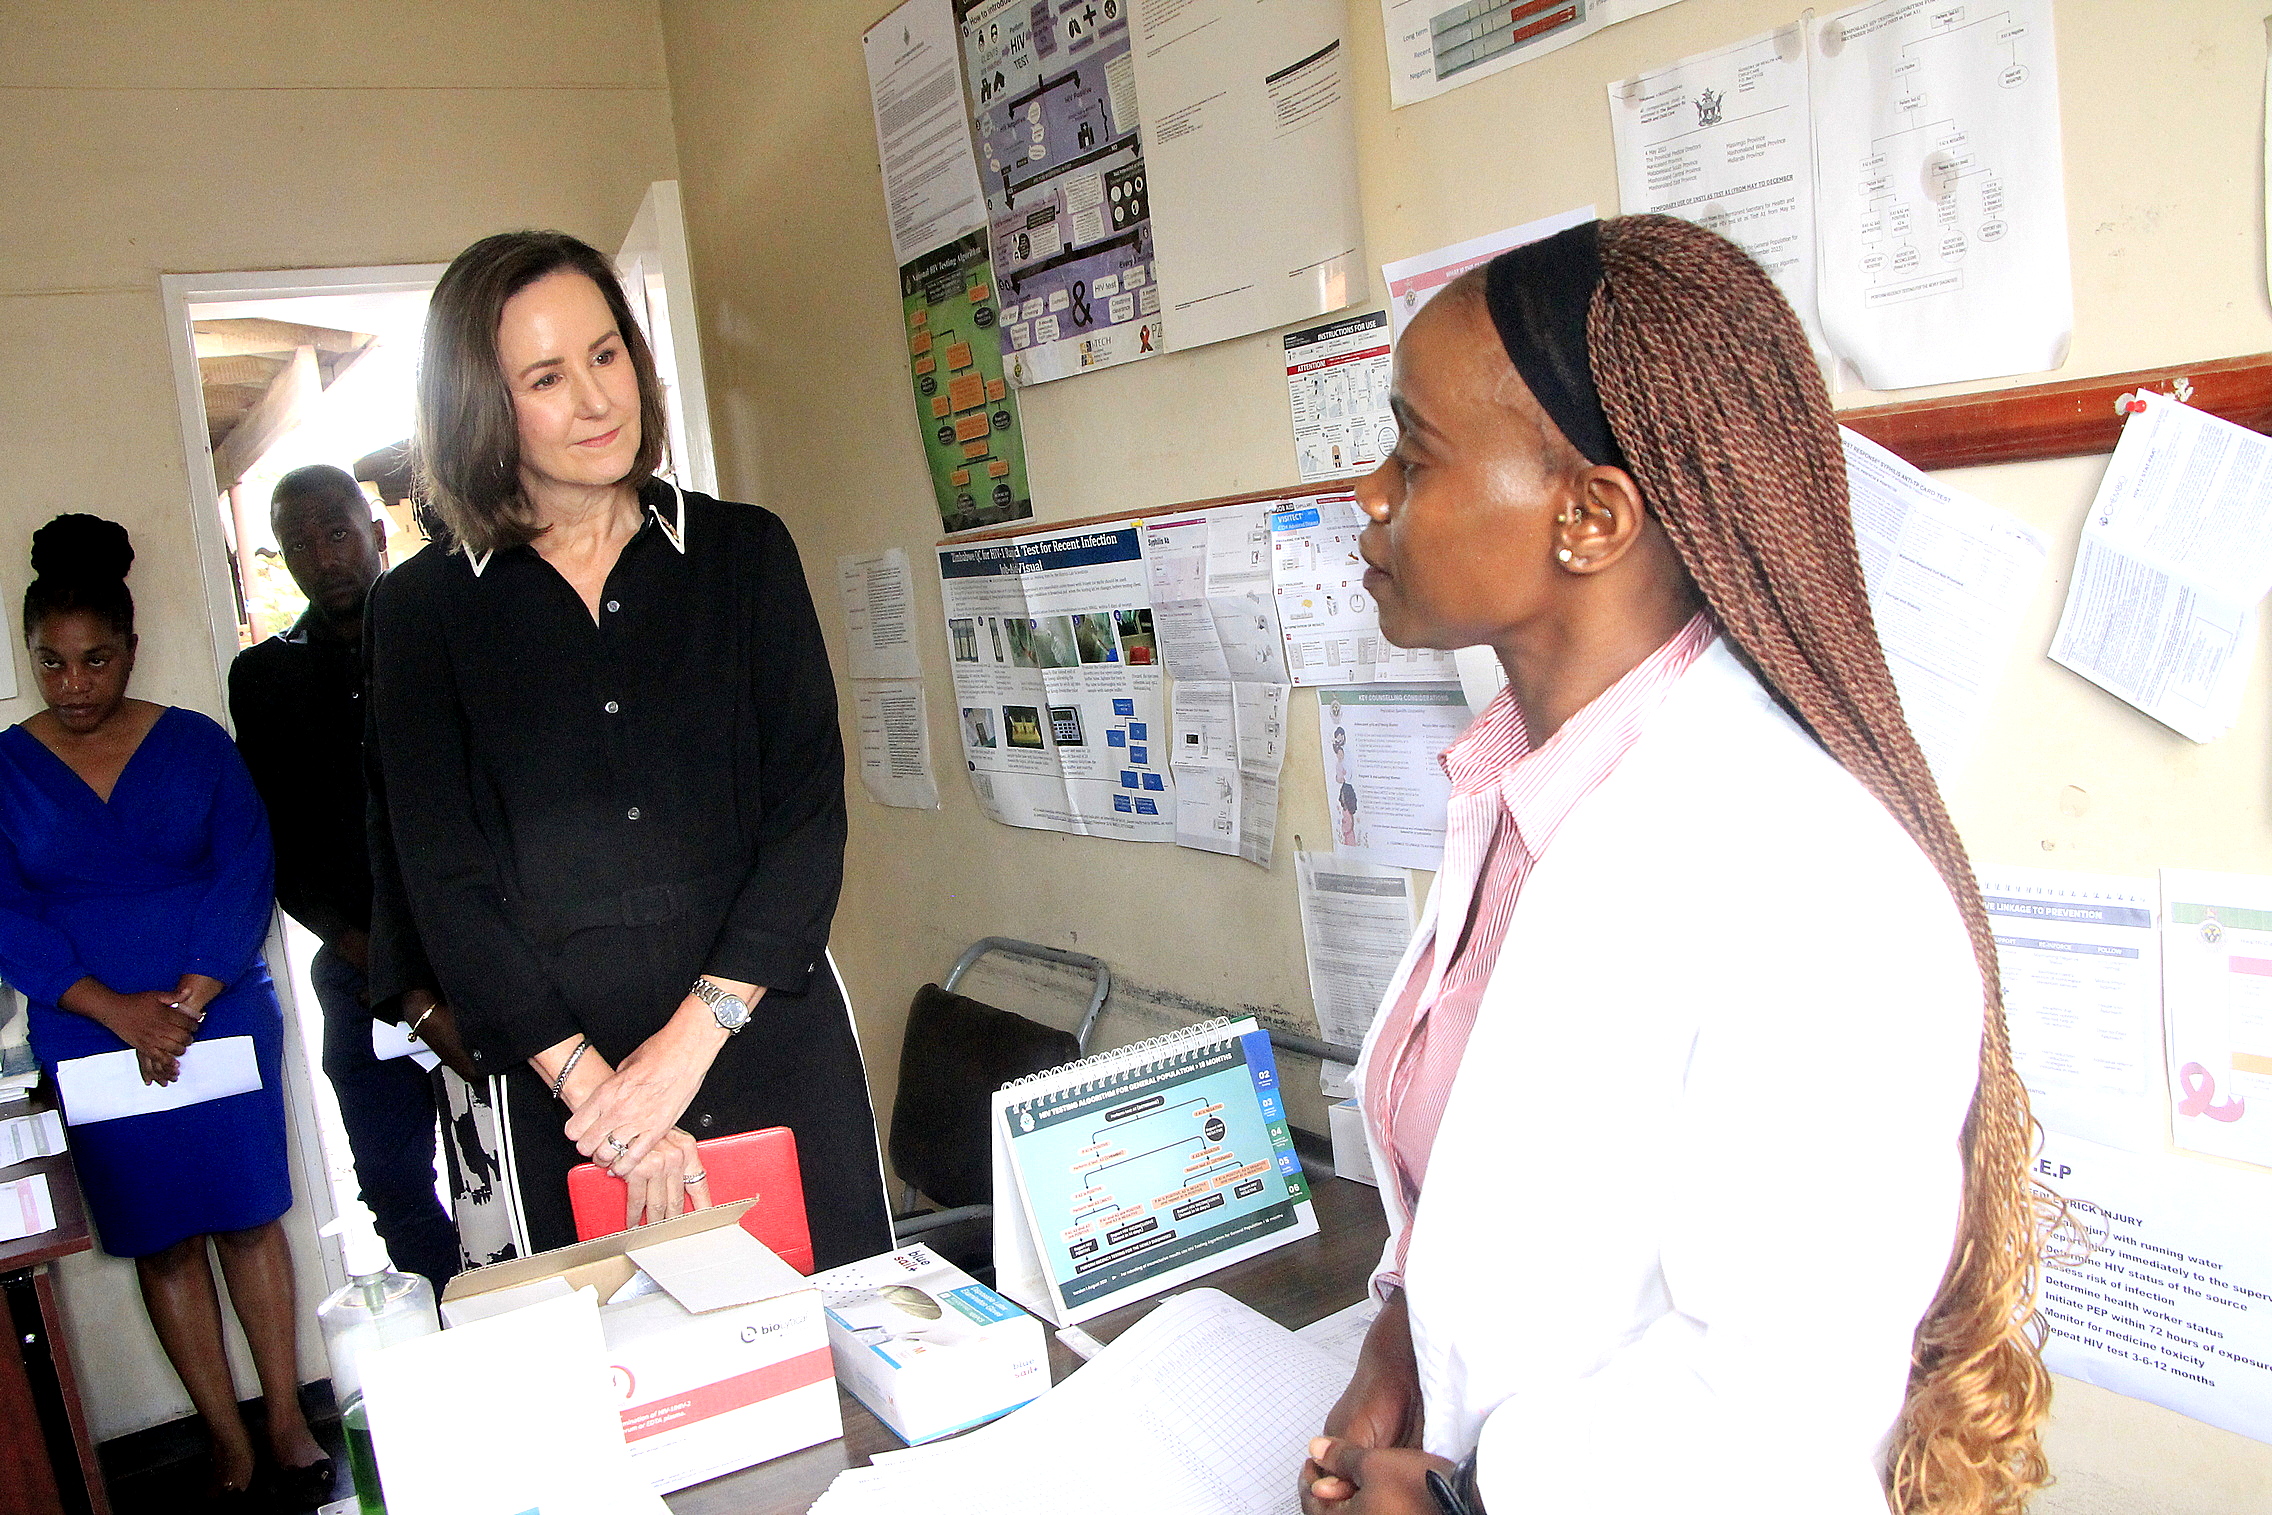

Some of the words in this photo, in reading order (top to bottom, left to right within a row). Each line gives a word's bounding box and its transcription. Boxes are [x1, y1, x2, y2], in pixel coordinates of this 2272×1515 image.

[1010, 32, 1025, 55] HIV
[1403, 32, 1416, 42] Long
[1014, 54, 1030, 70] TEST
[1414, 48, 1431, 59] Recent
[1409, 68, 1432, 80] Negative
[1650, 200, 1676, 214] TEMPORARY
[1676, 199, 1685, 207] USE
[1746, 182, 1757, 190] MAY
[1765, 172, 1793, 187] DECEMBER
[1095, 282, 1106, 292] HIV
[1107, 280, 1117, 290] test
[1072, 280, 1093, 328] &
[1317, 326, 1354, 341] INSTRUCTIONS
[1354, 323, 1365, 332] FOR
[1365, 320, 1376, 330] USE
[1936, 492, 1951, 503] TEST
[1277, 513, 1302, 524] VISITECT
[1022, 544, 1040, 557] Test
[1040, 543, 1052, 554] for
[1053, 540, 1080, 553] Recent
[1081, 534, 1117, 548] Infection
[1997, 903, 2031, 914] LINKAGE
[2032, 906, 2044, 915] TO
[2045, 906, 2103, 920] PREVENTION
[1258, 1070, 1270, 1080] 02
[1038, 1109, 1052, 1119] HIV
[1050, 1099, 1079, 1116] TESTING
[1077, 1087, 1116, 1108] ALGORITHM
[1114, 1084, 1129, 1095] FOR
[1127, 1075, 1156, 1091] GENERAL
[1156, 1063, 1195, 1083] POPULATION
[1204, 1051, 1233, 1067] MONTHS
[1263, 1098, 1273, 1107] 03
[1271, 1127, 1282, 1137] 04
[1279, 1156, 1290, 1166] 05
[1288, 1183, 1300, 1194] 06
[2101, 1209, 2143, 1228] INJURY
[907, 1249, 931, 1266] blue
[2113, 1233, 2137, 1246] with
[2140, 1241, 2184, 1262] running
[2187, 1253, 2224, 1270] water
[2118, 1249, 2189, 1279] immediately
[2193, 1273, 2205, 1282] to
[2209, 1276, 2229, 1289] the
[2046, 1260, 2083, 1279] Assess
[2086, 1273, 2107, 1286] risk
[2111, 1280, 2122, 1289] of
[2124, 1284, 2176, 1307] infection
[2104, 1261, 2125, 1274] HIV
[2128, 1268, 2164, 1286] status
[2168, 1281, 2179, 1291] of
[2182, 1285, 2202, 1298] the
[2205, 1292, 2248, 1311] source
[2045, 1275, 2101, 1299] Determine
[2104, 1293, 2140, 1312] health
[2142, 1306, 2183, 1326] worker
[2186, 1320, 2224, 1339] status
[2045, 1291, 2084, 1310] Initiate
[2086, 1304, 2108, 1317] PEP
[2111, 1314, 2146, 1332] within
[2149, 1324, 2163, 1336] 72
[2166, 1331, 2199, 1348] hours
[2202, 1343, 2215, 1353] of
[2044, 1307, 2085, 1327] Monitor
[2087, 1321, 2103, 1332] for
[2105, 1328, 2157, 1351] medicine
[2160, 1345, 2205, 1369] toxicity
[912, 1346, 927, 1355] M
[1013, 1358, 1035, 1370] blue
[2084, 1336, 2104, 1349] HIV
[2107, 1345, 2128, 1359] test
[2132, 1353, 2167, 1371] 3-6-12
[2171, 1367, 2216, 1388] months
[622, 1414, 650, 1427] mination
[650, 1411, 658, 1421] of
[638, 1422, 646, 1430] or
[646, 1417, 663, 1428] EDTA
[663, 1411, 686, 1424] plasma.
